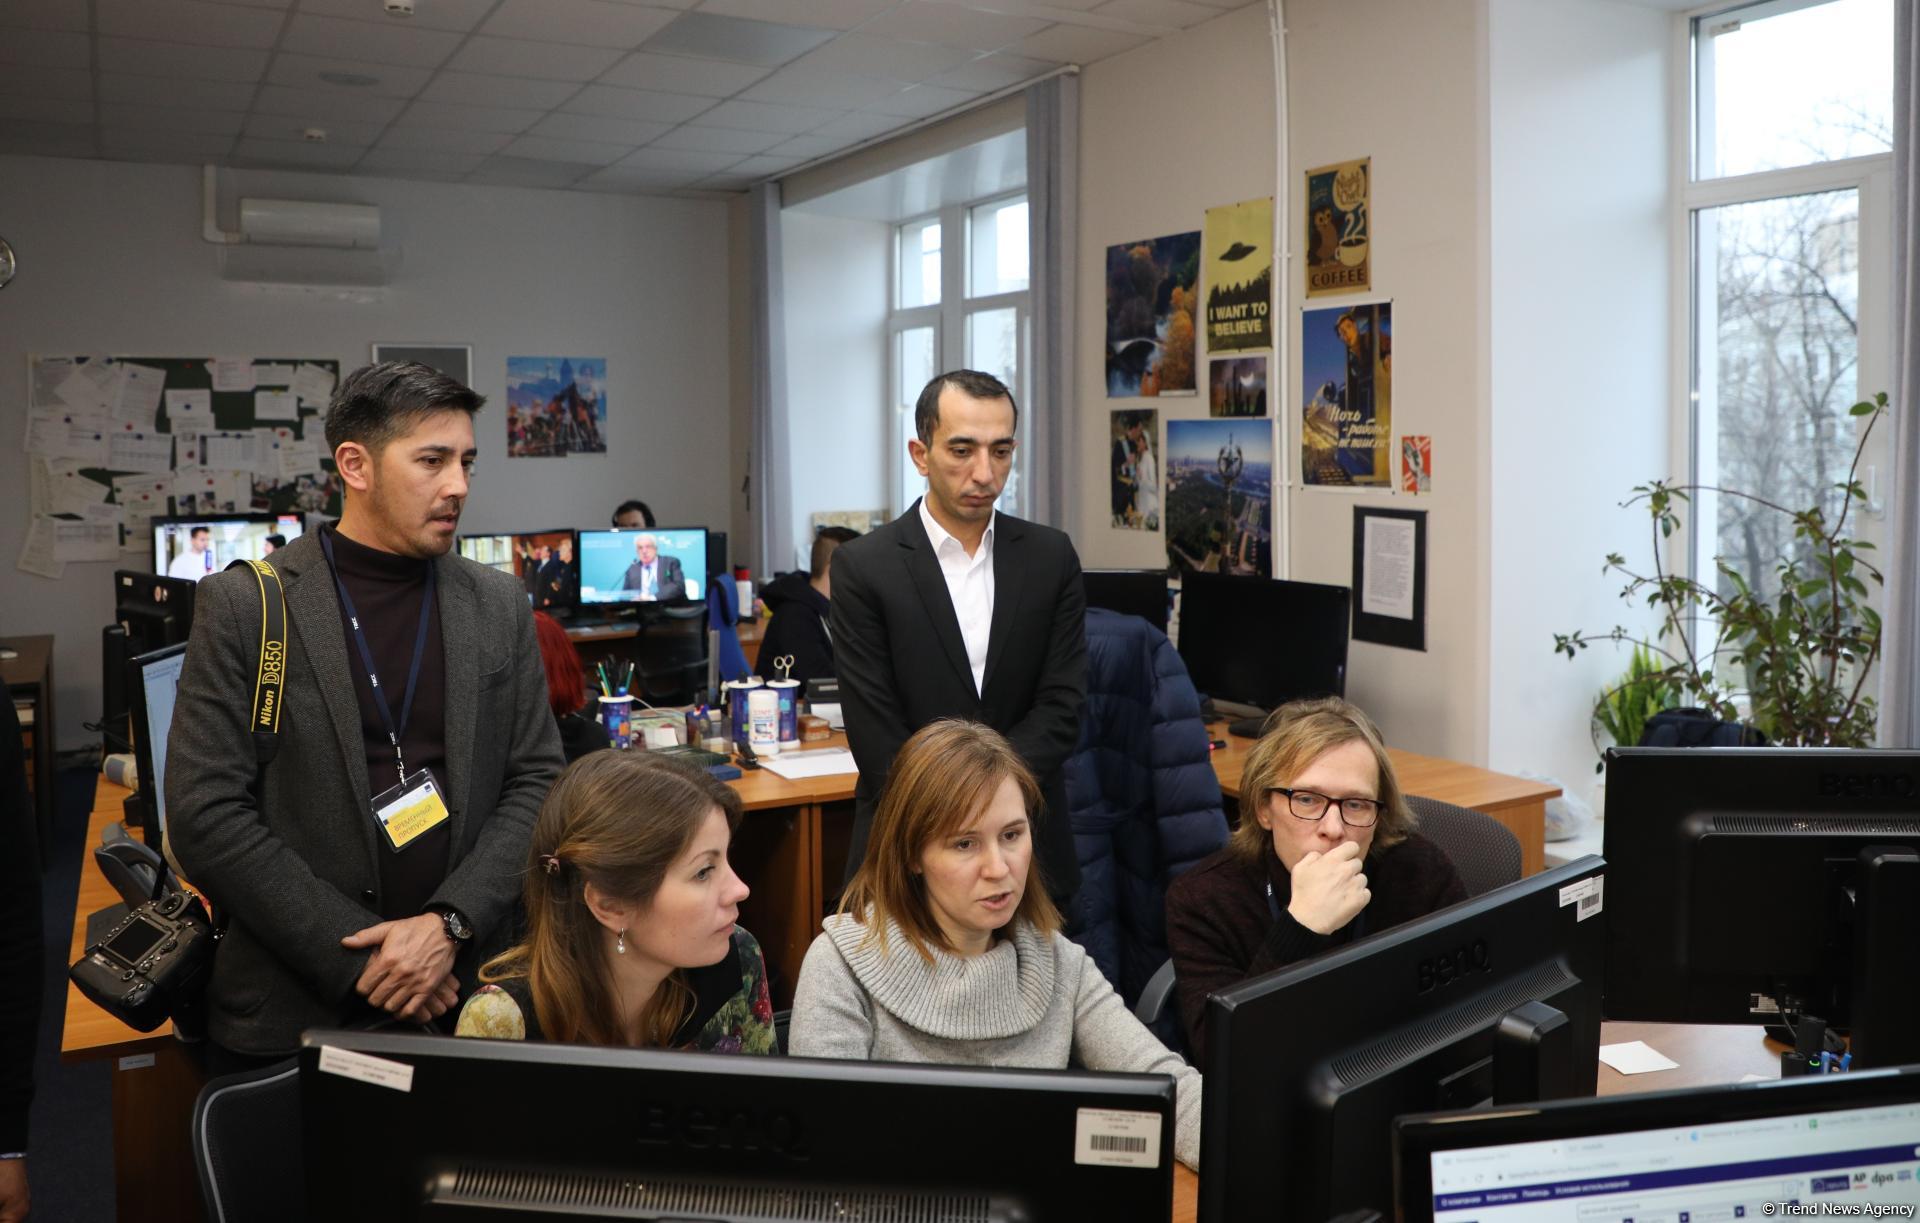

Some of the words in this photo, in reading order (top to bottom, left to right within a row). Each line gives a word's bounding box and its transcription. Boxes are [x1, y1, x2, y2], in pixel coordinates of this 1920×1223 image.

[1311, 268, 1365, 287] COFFEE
[1209, 307, 1214, 321] I
[1215, 303, 1248, 320] WANT
[1251, 301, 1268, 316] TO
[1215, 319, 1262, 337] BELIEVE
[1329, 404, 1362, 422] Ночь
[262, 640, 283, 685] D850
[260, 690, 275, 726] Nikon
[393, 804, 433, 831] ВРЕМЕННЫЙ
[398, 817, 428, 839] ПРОПУСК
[1416, 936, 1492, 995] BenQ
[637, 1100, 812, 1161] BenQ
[1871, 1170, 1894, 1186] dpa
